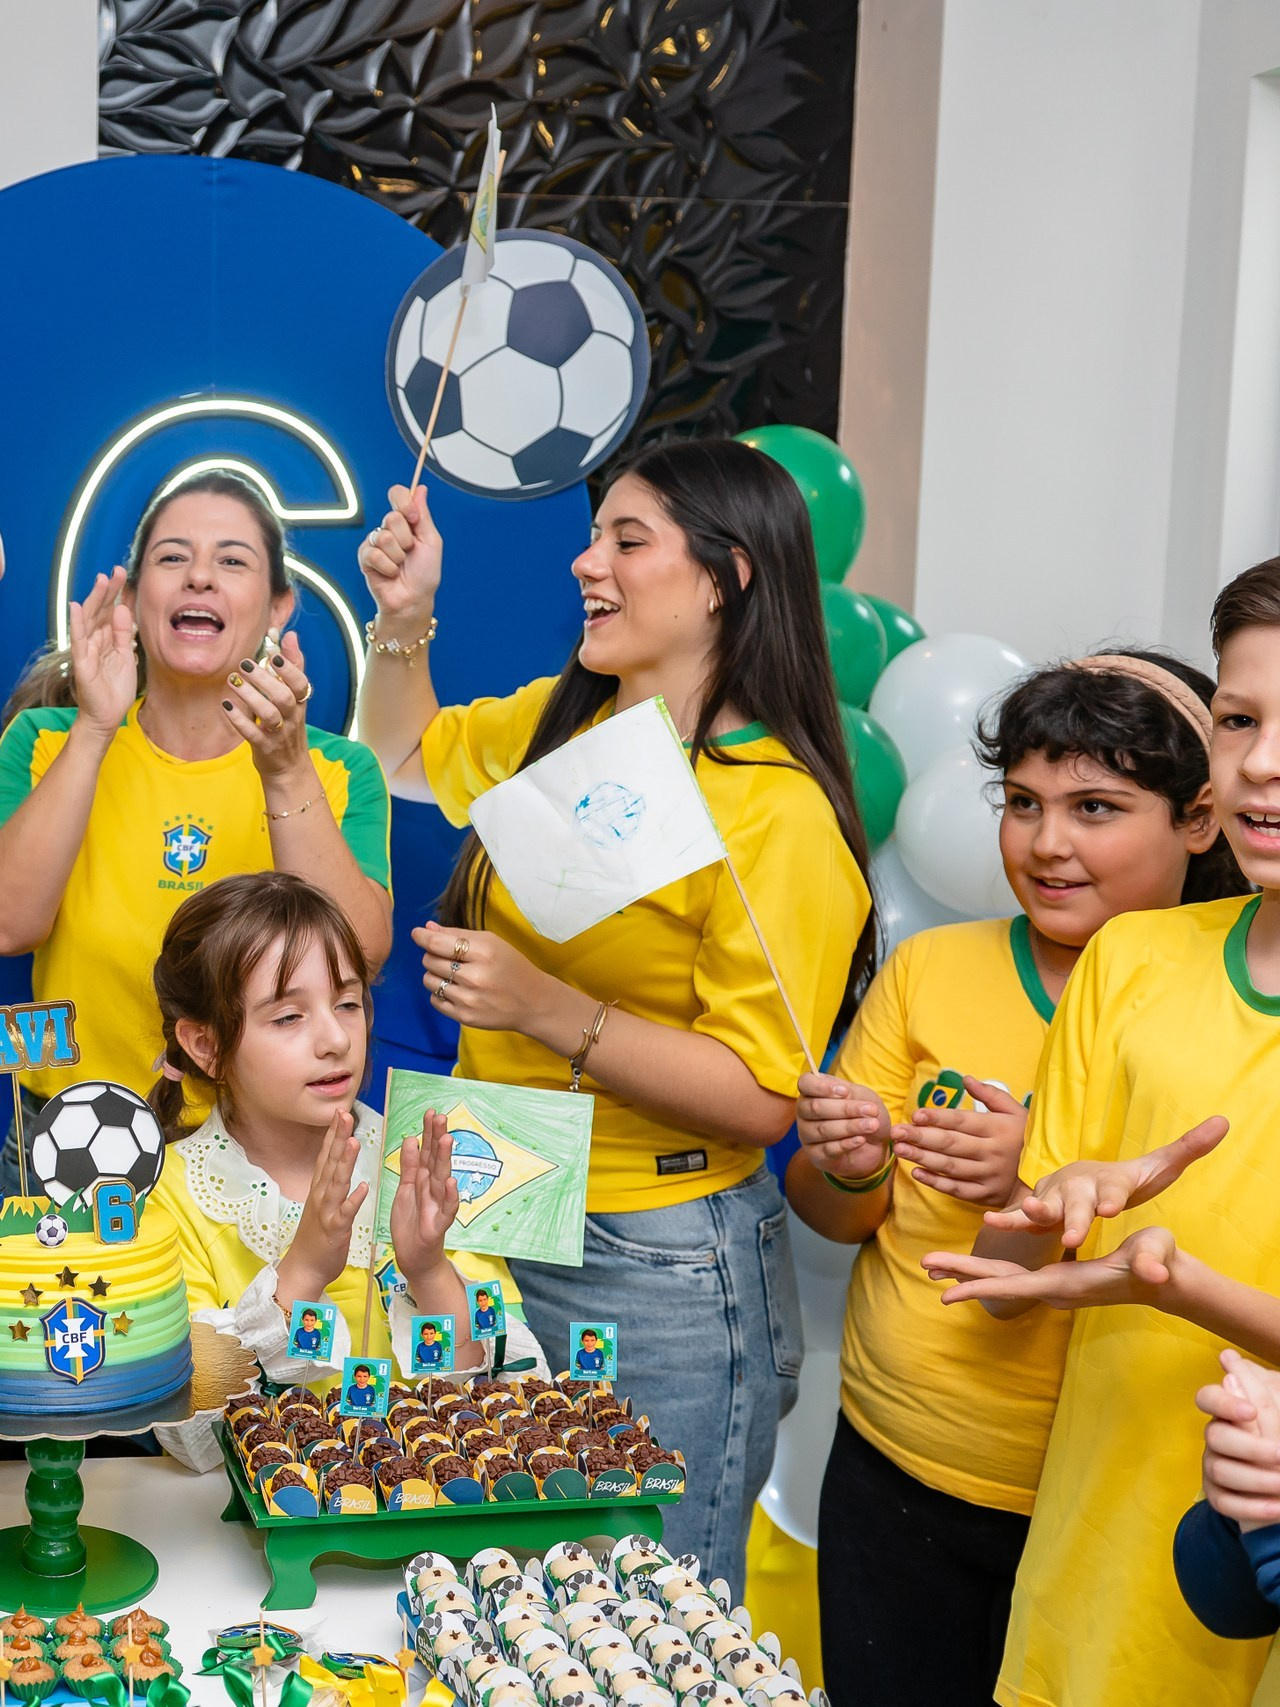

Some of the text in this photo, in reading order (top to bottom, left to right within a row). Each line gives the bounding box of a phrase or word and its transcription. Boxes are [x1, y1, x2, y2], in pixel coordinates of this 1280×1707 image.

[177, 844, 195, 852] CBF
[459, 1160, 497, 1171] PROGRESSO
[96, 1181, 136, 1244] 6
[393, 1283, 406, 1293] CB
[62, 1332, 87, 1344] CBF
